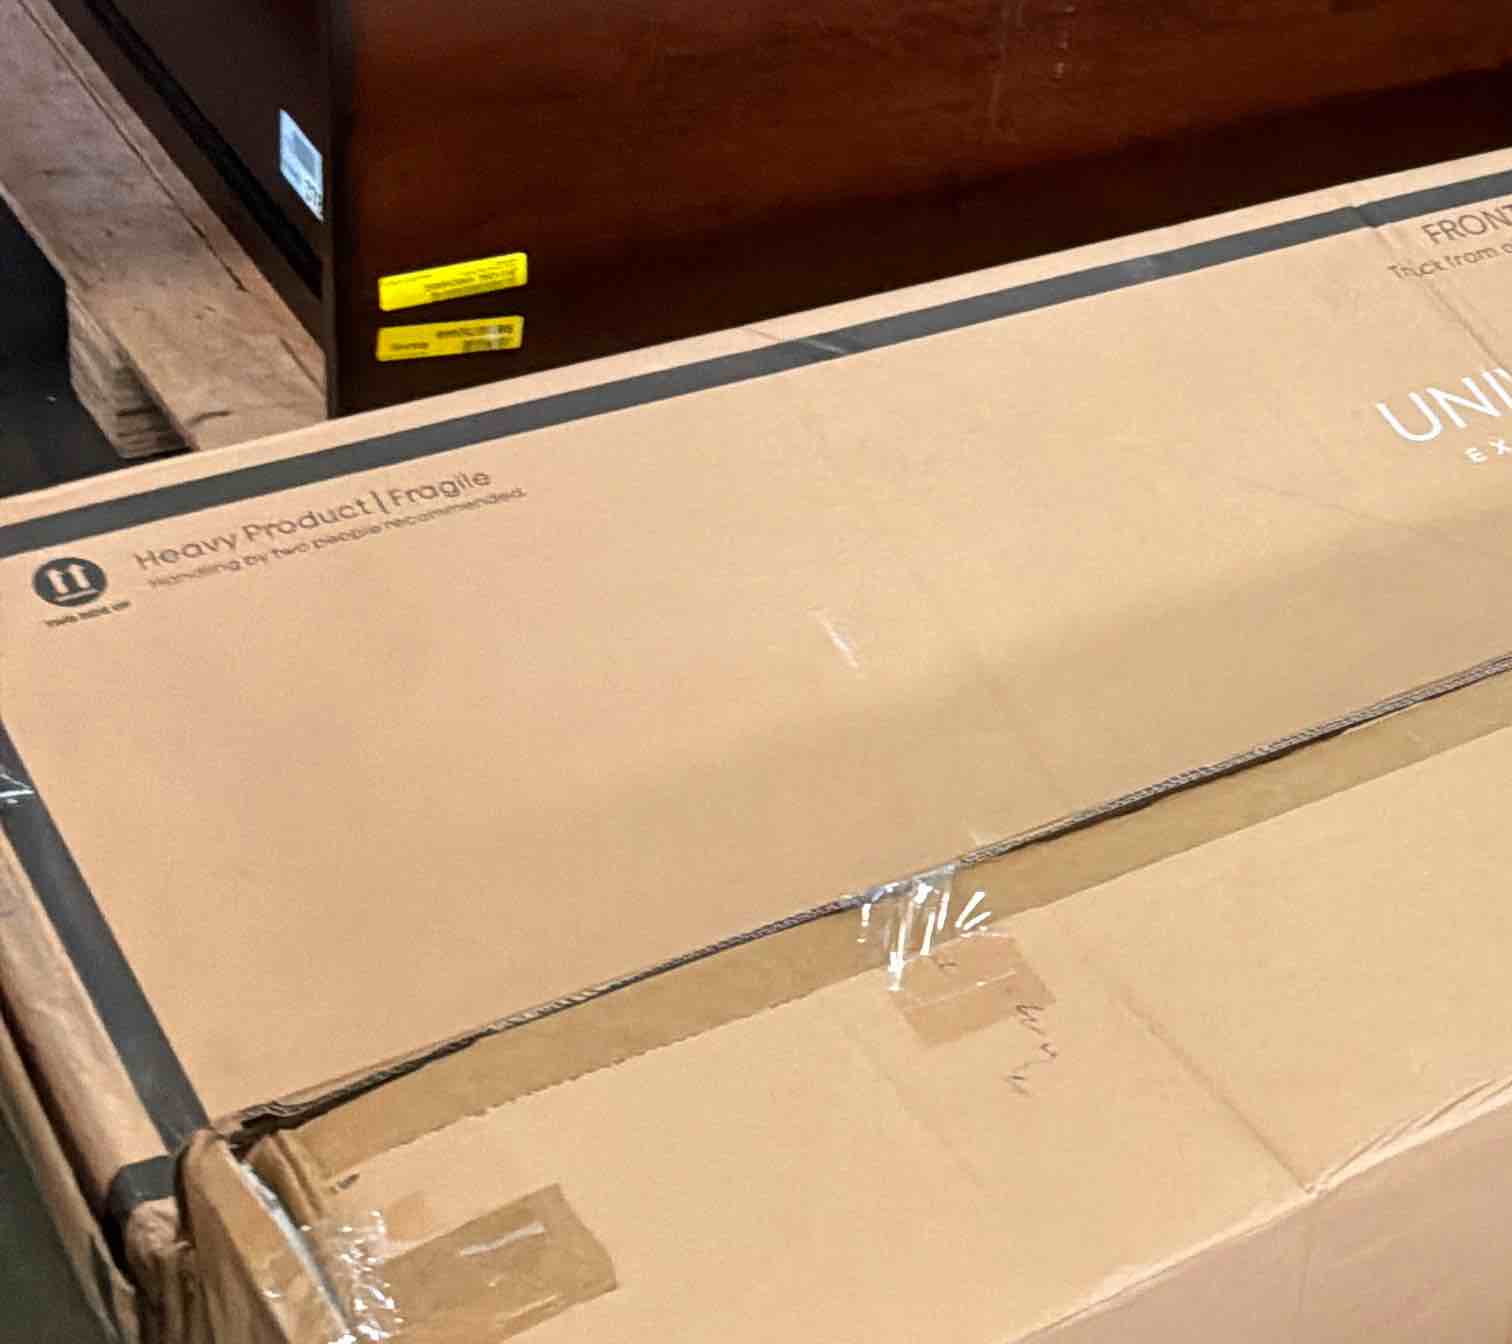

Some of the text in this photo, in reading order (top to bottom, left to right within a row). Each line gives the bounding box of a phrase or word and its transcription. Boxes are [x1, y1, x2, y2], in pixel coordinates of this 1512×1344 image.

[134, 524, 240, 572] Heavy
[242, 496, 370, 544] Product
[388, 467, 492, 518] Fragile
[271, 538, 311, 562] two
